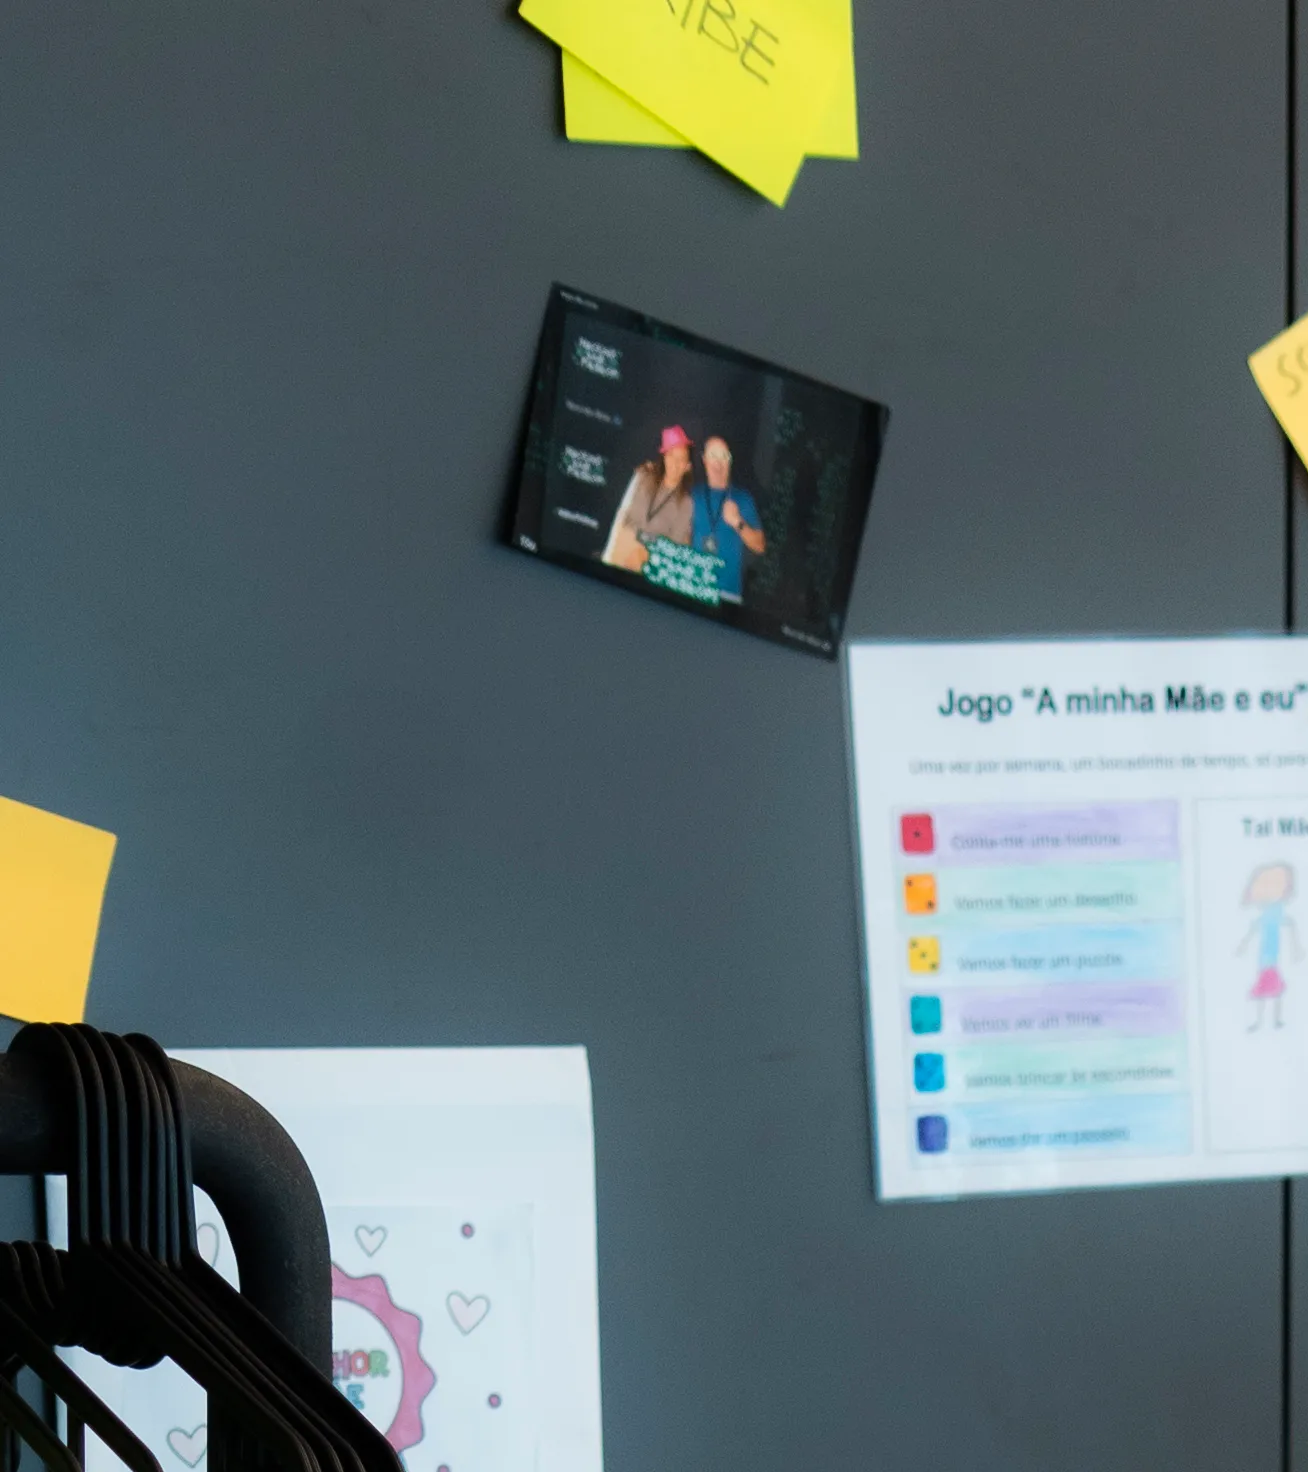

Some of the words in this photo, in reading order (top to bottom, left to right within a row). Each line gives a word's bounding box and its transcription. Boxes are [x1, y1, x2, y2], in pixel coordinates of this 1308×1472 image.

[939, 687, 1014, 723] Jogo
[1066, 685, 1155, 715] minha
[1164, 683, 1226, 713] Mãe
[1235, 692, 1252, 713] e
[1242, 814, 1273, 837] Tal
